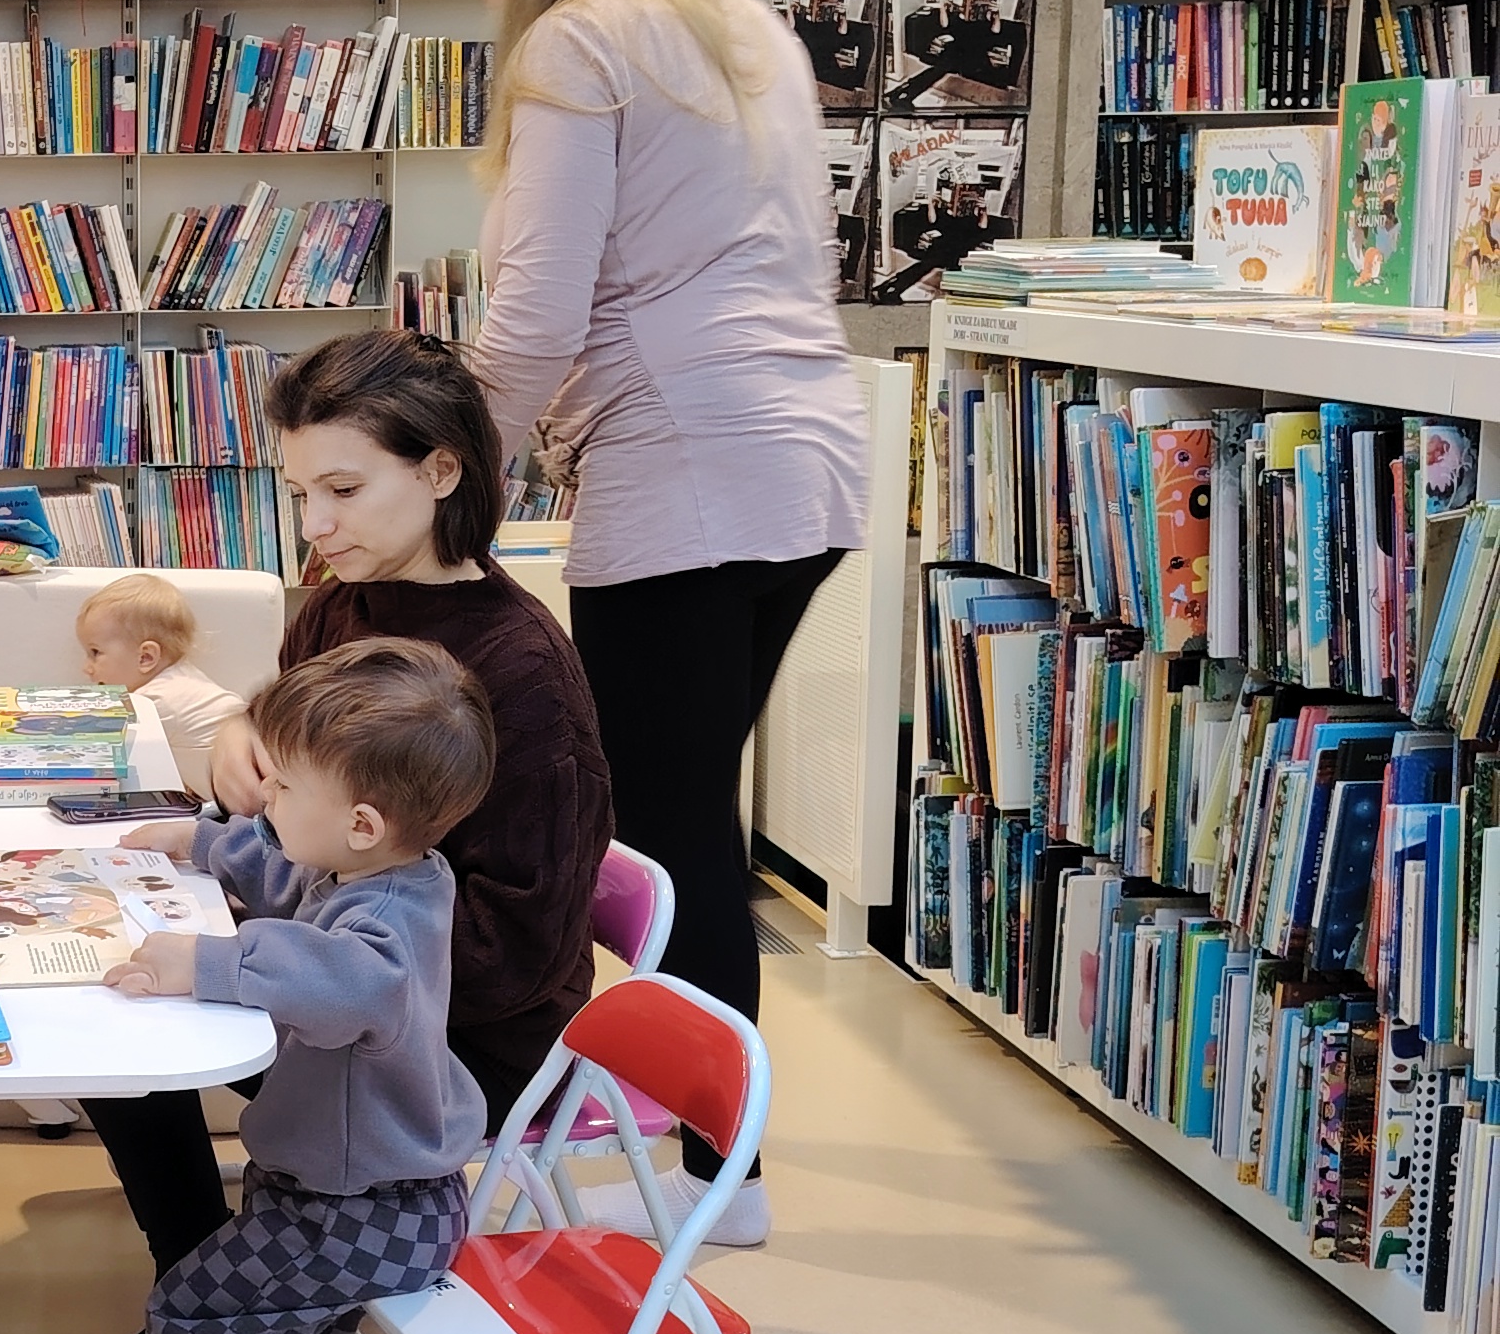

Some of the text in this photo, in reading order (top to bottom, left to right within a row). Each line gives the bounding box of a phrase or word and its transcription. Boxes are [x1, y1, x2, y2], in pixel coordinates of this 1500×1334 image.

[1212, 168, 1268, 196] TOFU
[1363, 180, 1385, 194] KAKO
[1226, 197, 1288, 226] TUNA
[1365, 197, 1380, 210] STE
